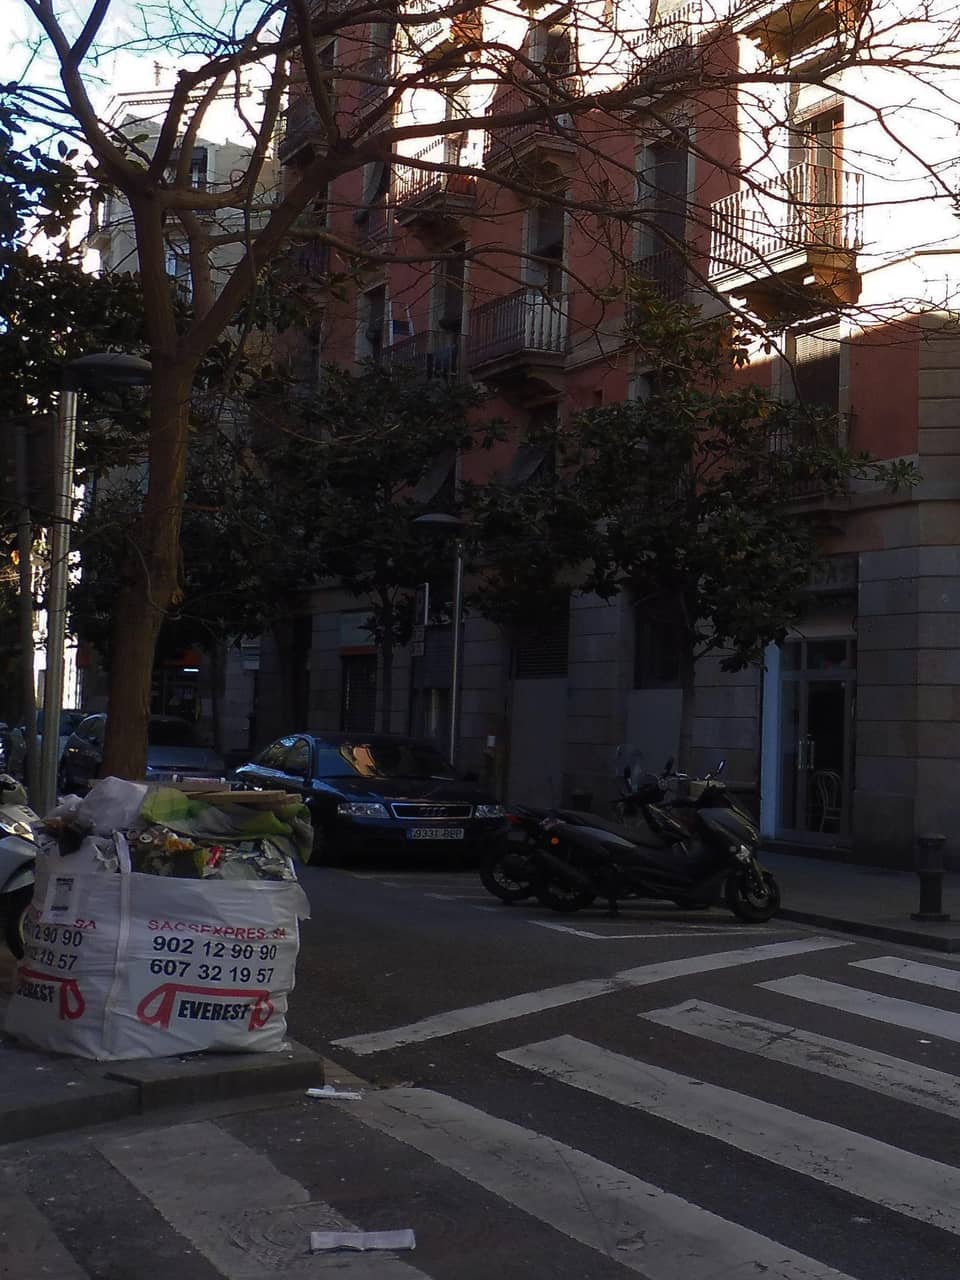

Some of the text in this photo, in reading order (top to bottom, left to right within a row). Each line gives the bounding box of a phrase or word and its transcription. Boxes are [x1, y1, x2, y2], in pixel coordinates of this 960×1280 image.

[43, 927, 58, 943] 90
[62, 930, 83, 947] 90
[152, 935, 278, 961] 902 12 90 90
[57, 954, 78, 971] 57
[150, 958, 275, 984] 607 32 19 57
[177, 999, 250, 1021] EVEREST
